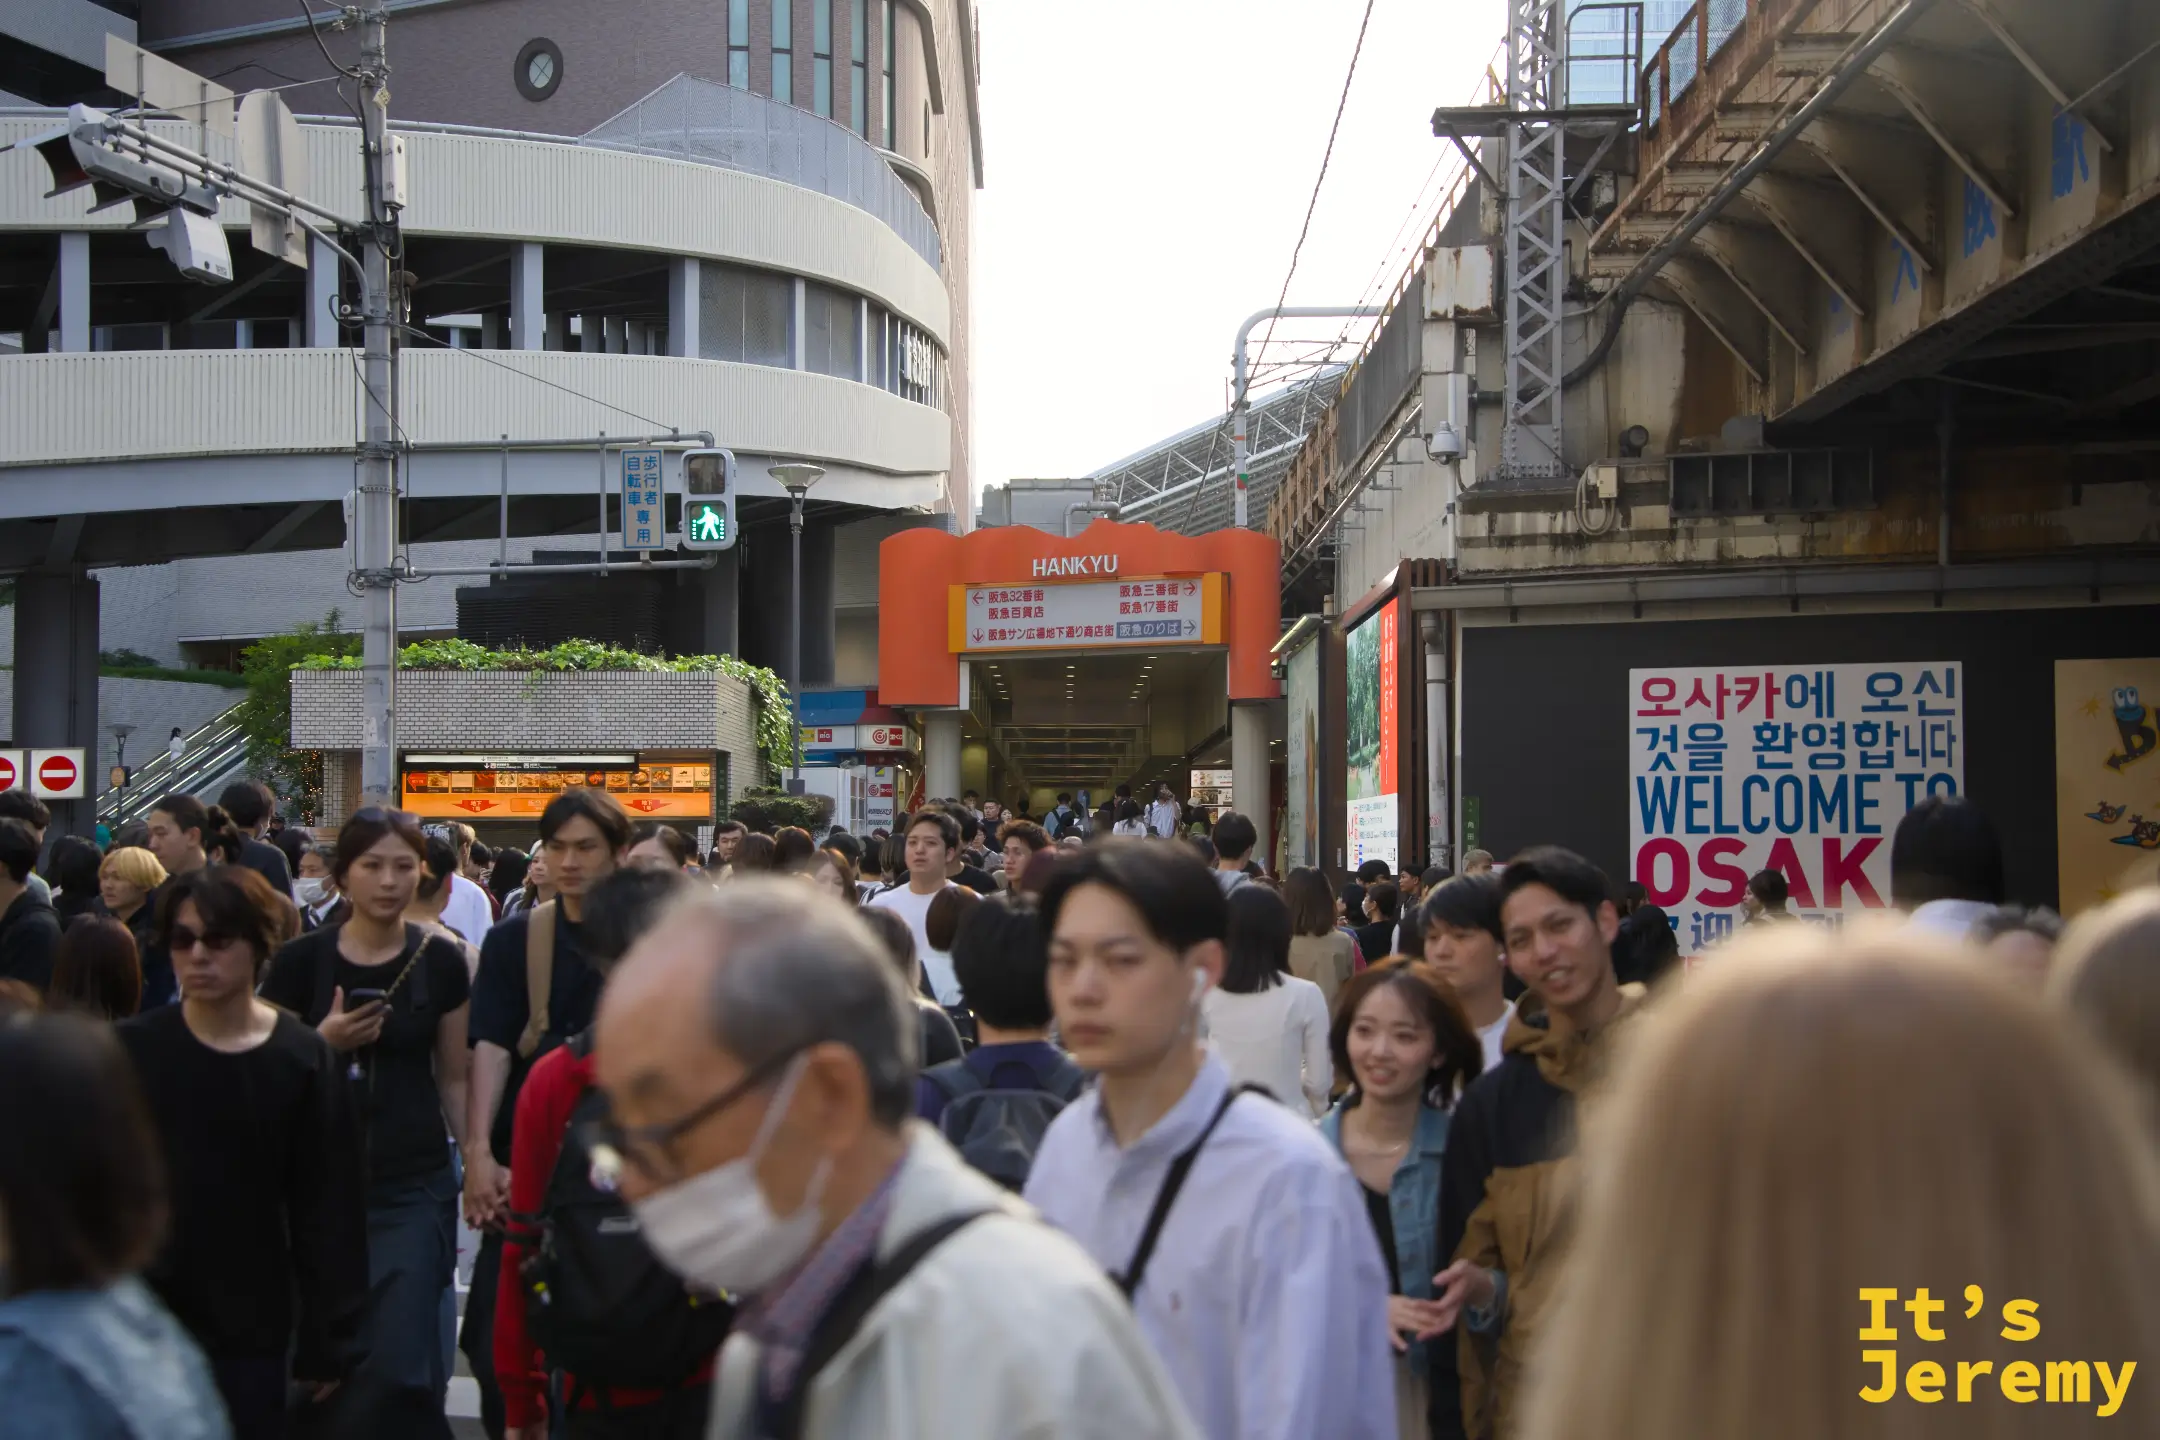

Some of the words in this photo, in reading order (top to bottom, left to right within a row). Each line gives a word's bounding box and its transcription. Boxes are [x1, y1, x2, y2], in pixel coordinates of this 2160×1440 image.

[627, 456, 641, 506] 自転車
[644, 455, 658, 505] 歩行者
[636, 509, 651, 544] 専用
[1033, 554, 1118, 577] HANKYU
[988, 589, 1044, 604] 阪急32番街
[1120, 583, 1179, 597] 阪急三番街
[1120, 600, 1179, 615] 阪急17番街
[988, 606, 1044, 620] 阪急百貨店
[1637, 671, 1834, 720] 오사카에
[1861, 668, 1956, 717] 오신
[1636, 723, 1728, 772] 것을
[1752, 719, 1957, 771] 환영합니다
[1636, 774, 1882, 835] WELCOME
[1636, 837, 1890, 908] OSAK
